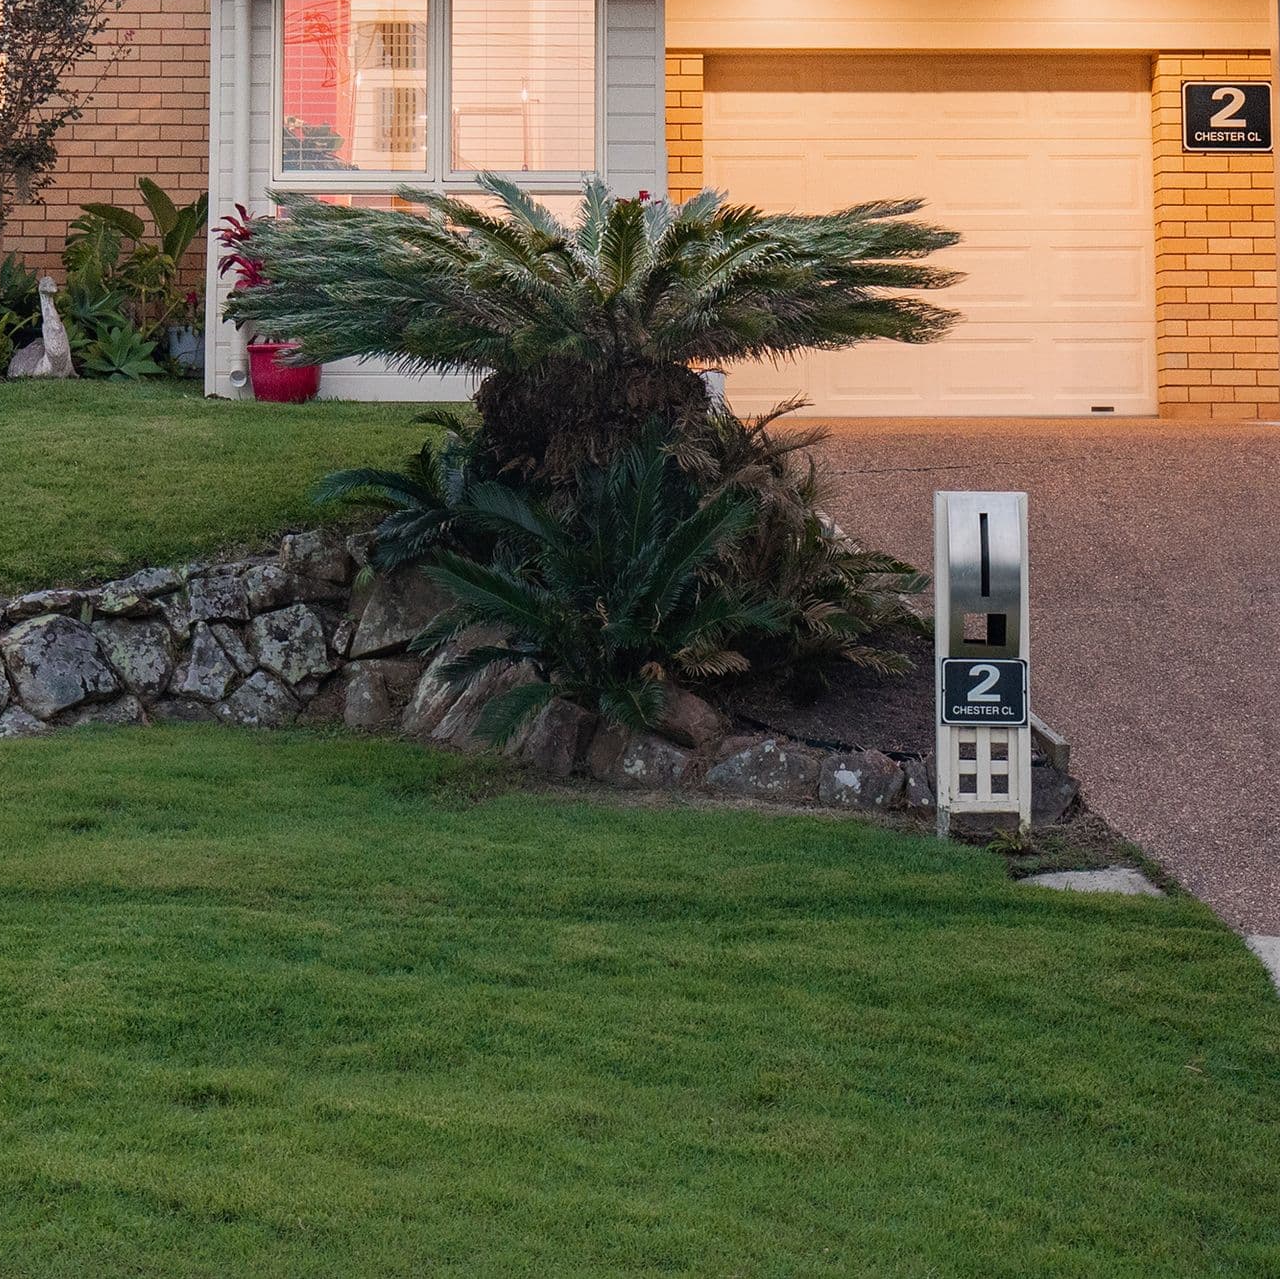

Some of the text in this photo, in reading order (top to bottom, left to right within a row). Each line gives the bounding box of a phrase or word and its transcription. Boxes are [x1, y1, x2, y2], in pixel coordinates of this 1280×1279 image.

[1210, 87, 1246, 127] 2
[1194, 131, 1262, 141] CHESTER CL
[967, 664, 1001, 702] 2
[952, 705, 1015, 715] CHESTER CL
